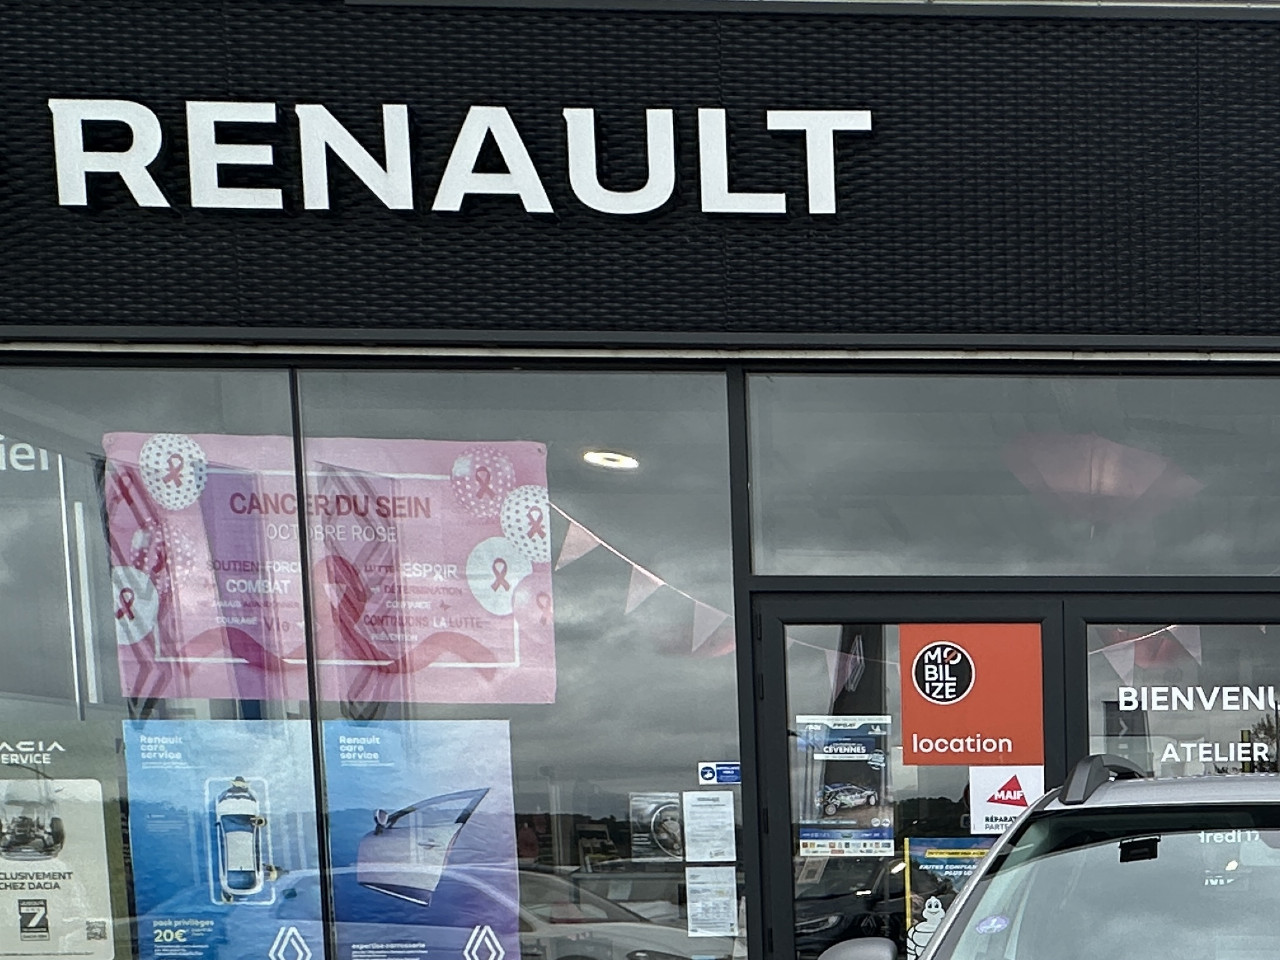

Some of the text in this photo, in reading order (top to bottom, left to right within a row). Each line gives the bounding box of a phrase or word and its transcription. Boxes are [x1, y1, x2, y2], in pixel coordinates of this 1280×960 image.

[48, 98, 872, 214] RENAULT
[336, 493, 370, 518] DU
[375, 495, 432, 519] SEIN
[352, 525, 398, 544] ROSE
[266, 560, 301, 574] FORC
[226, 579, 291, 595] COMBAT
[433, 616, 448, 628] LA
[449, 617, 483, 629] LUTTE
[924, 664, 957, 681] BIL
[924, 682, 957, 699] IZE
[140, 735, 183, 744] Renault
[339, 735, 380, 745] Renault
[912, 733, 1013, 753] location
[0, 740, 66, 752] ACIA
[140, 744, 166, 752] care
[340, 744, 365, 752] care
[1, 753, 51, 764] ERVICE
[141, 751, 182, 760] service
[340, 751, 380, 760] service
[1160, 742, 1269, 763] ATELIER
[994, 789, 1025, 800] MAIF
[984, 814, 1017, 823] RÉPARAT
[0, 871, 73, 881] CLUSIVEMENT
[0, 881, 61, 891] CHEZ DACIA
[153, 928, 188, 943] 20€
